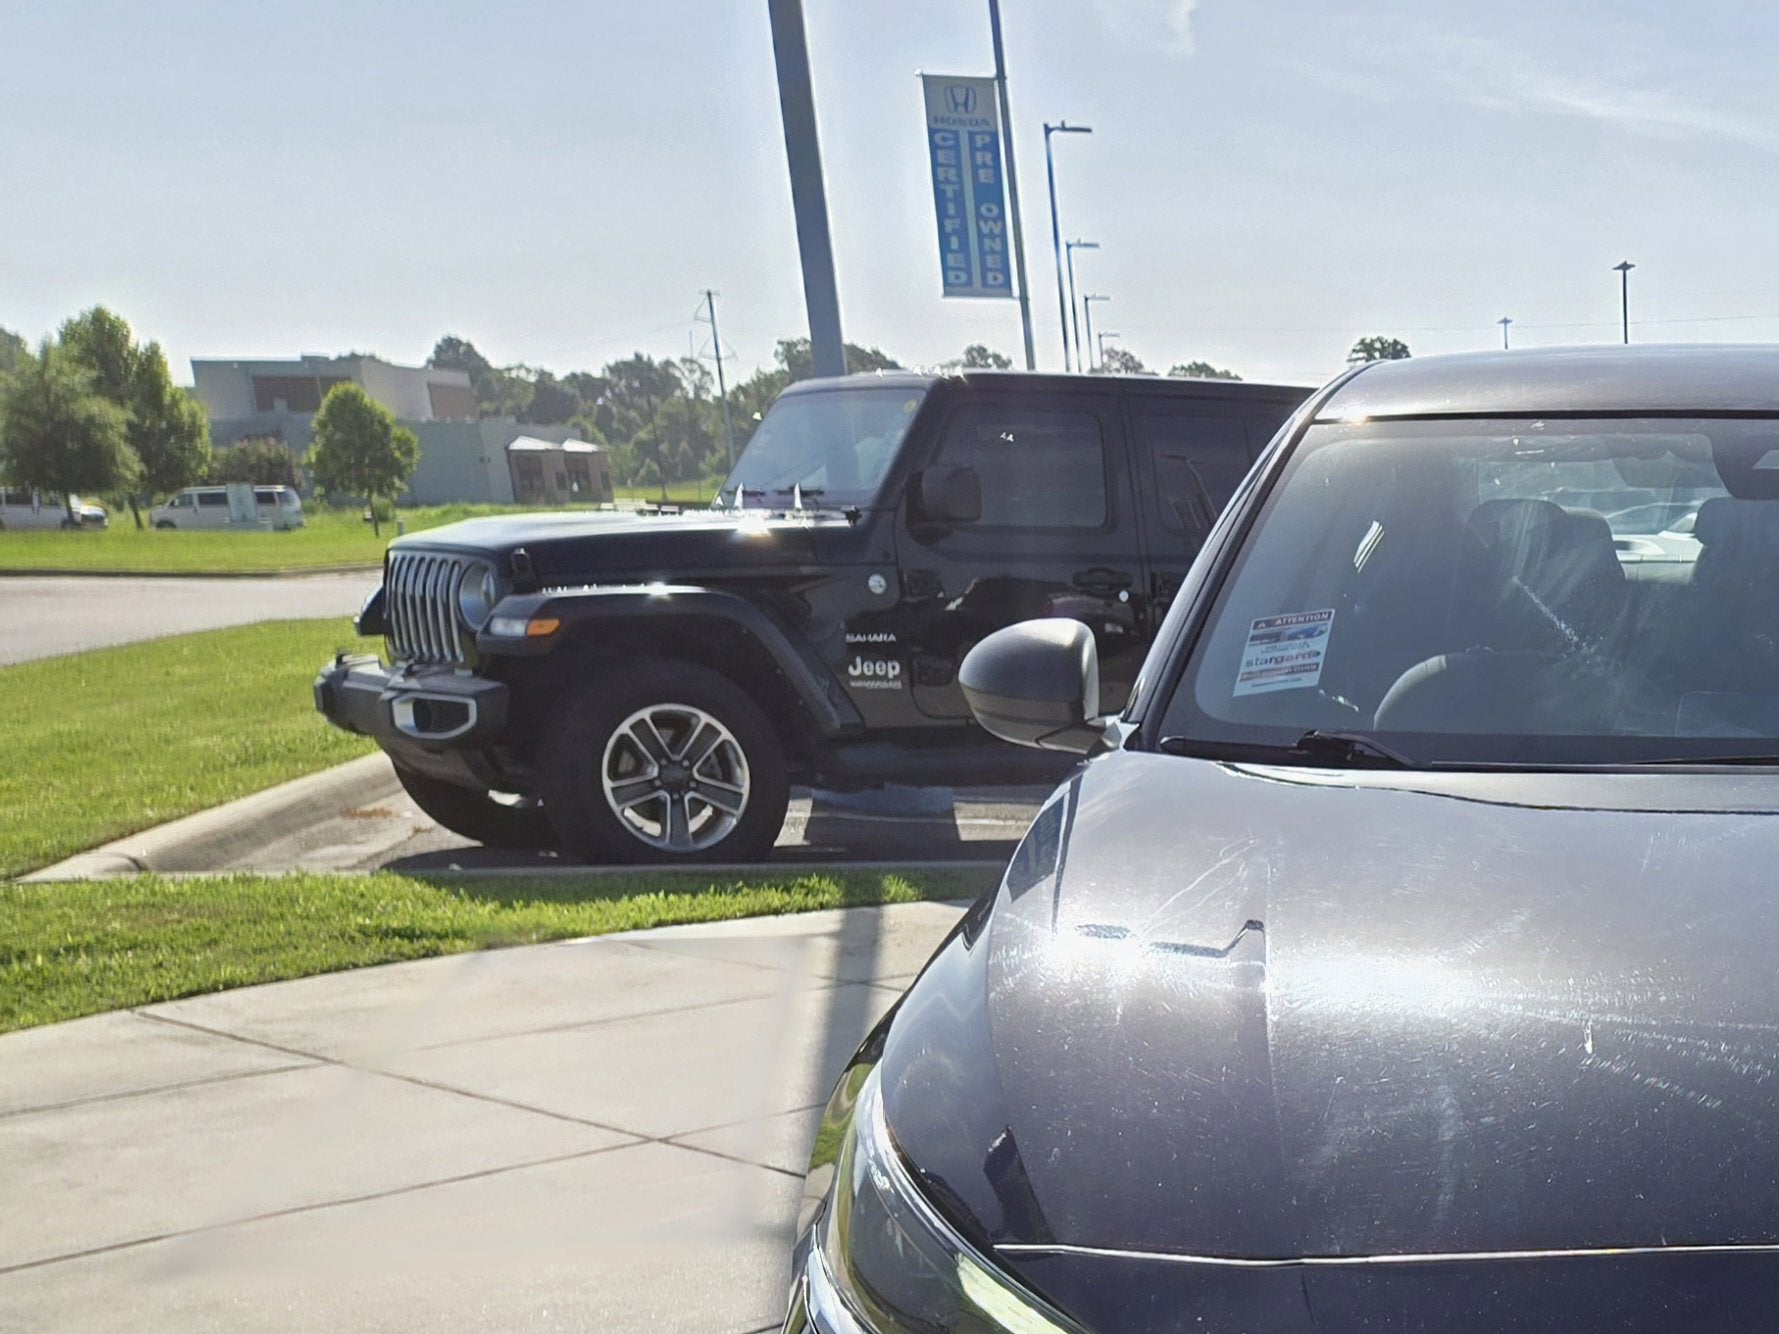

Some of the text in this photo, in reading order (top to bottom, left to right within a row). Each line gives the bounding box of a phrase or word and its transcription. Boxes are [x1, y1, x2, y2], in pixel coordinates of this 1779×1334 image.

[974, 132, 996, 184] PRE
[933, 131, 968, 284] CERTIFIED
[979, 202, 1005, 286] OWNED
[1274, 612, 1330, 626] ATTENTION
[847, 655, 901, 679] Jeep
